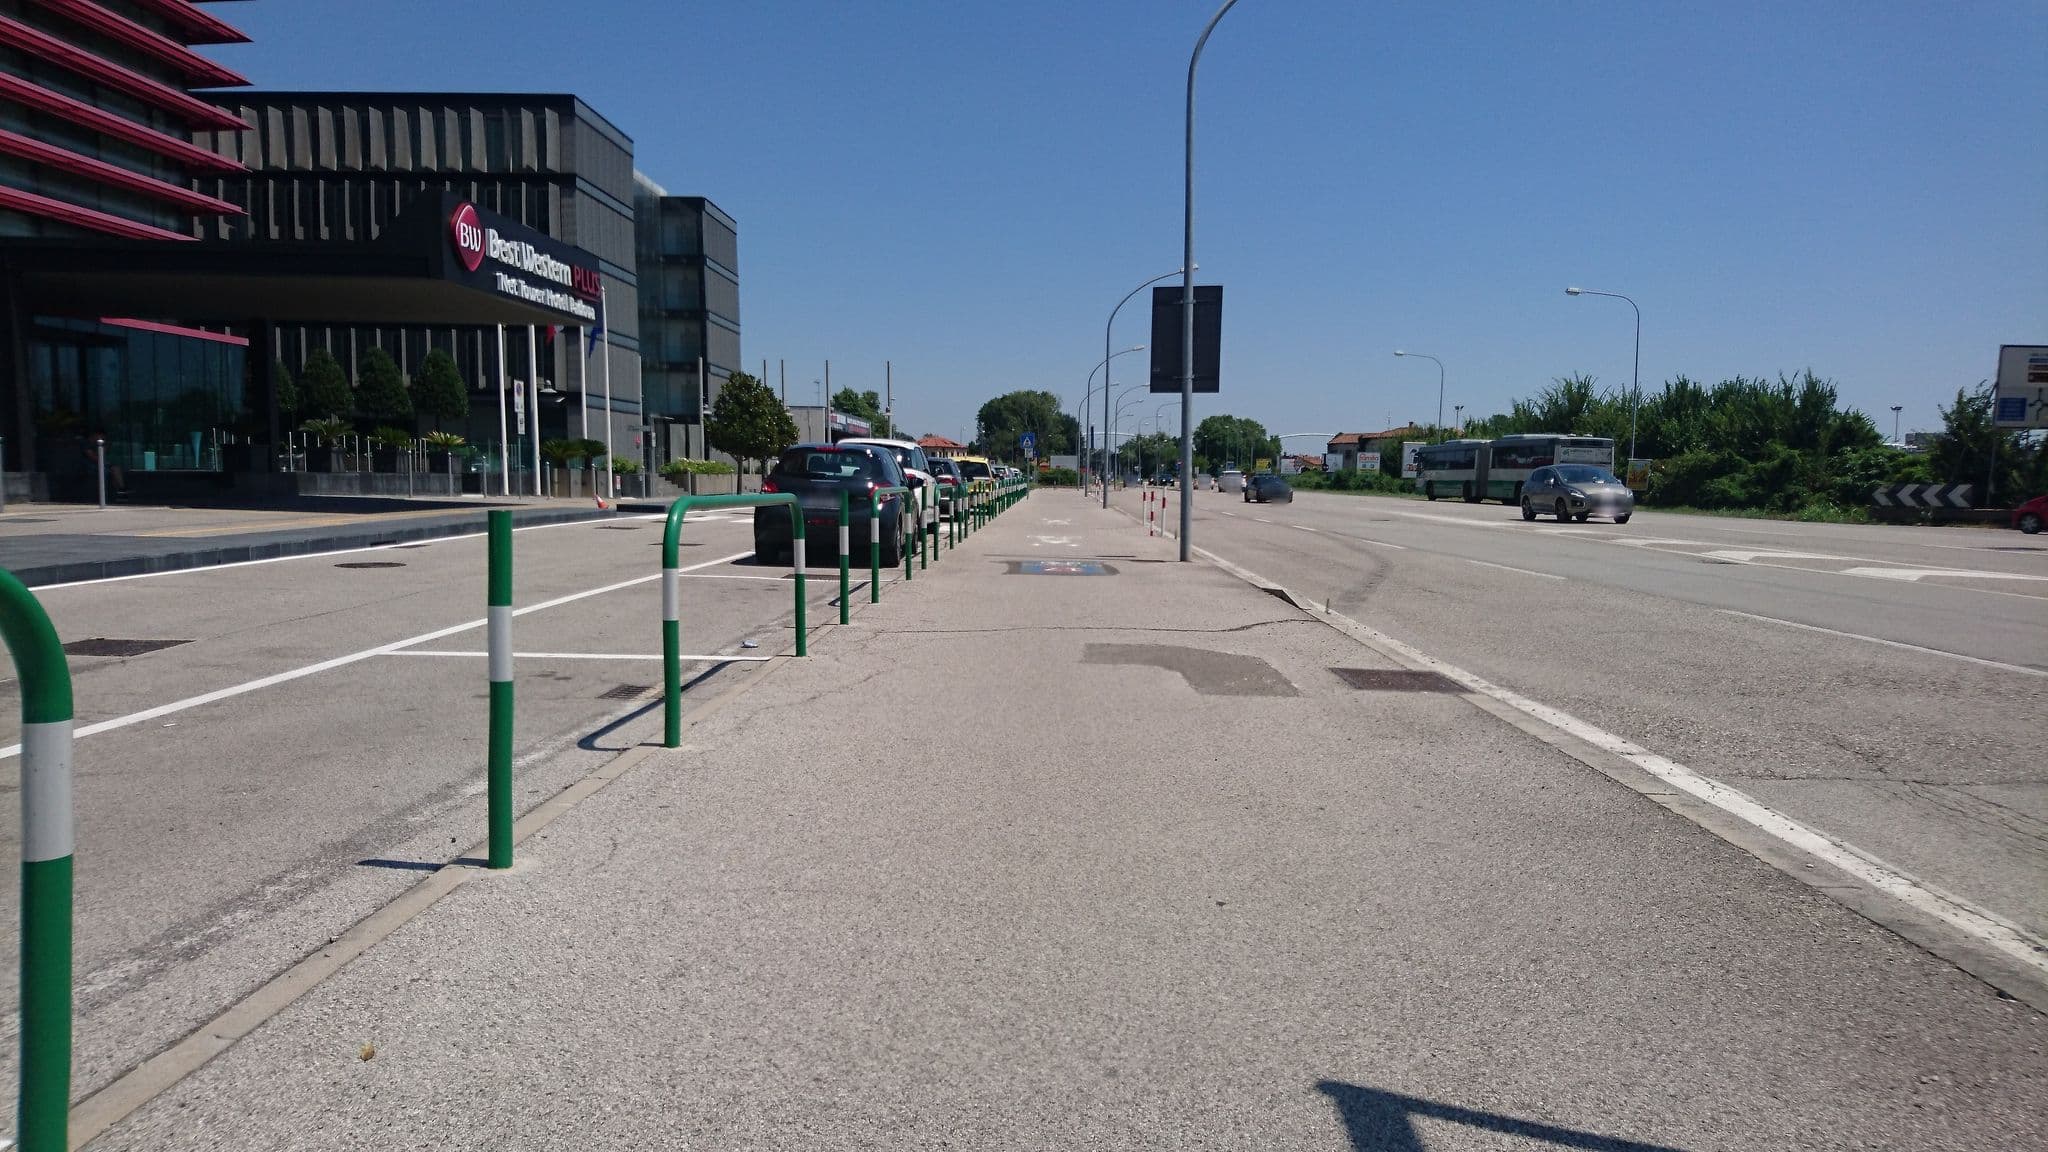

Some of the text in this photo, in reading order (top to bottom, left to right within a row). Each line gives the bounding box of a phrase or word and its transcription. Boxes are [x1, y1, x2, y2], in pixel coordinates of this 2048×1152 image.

[461, 222, 481, 252] BW
[485, 228, 600, 296] Best Western PLUS
[517, 279, 545, 305] Tower
